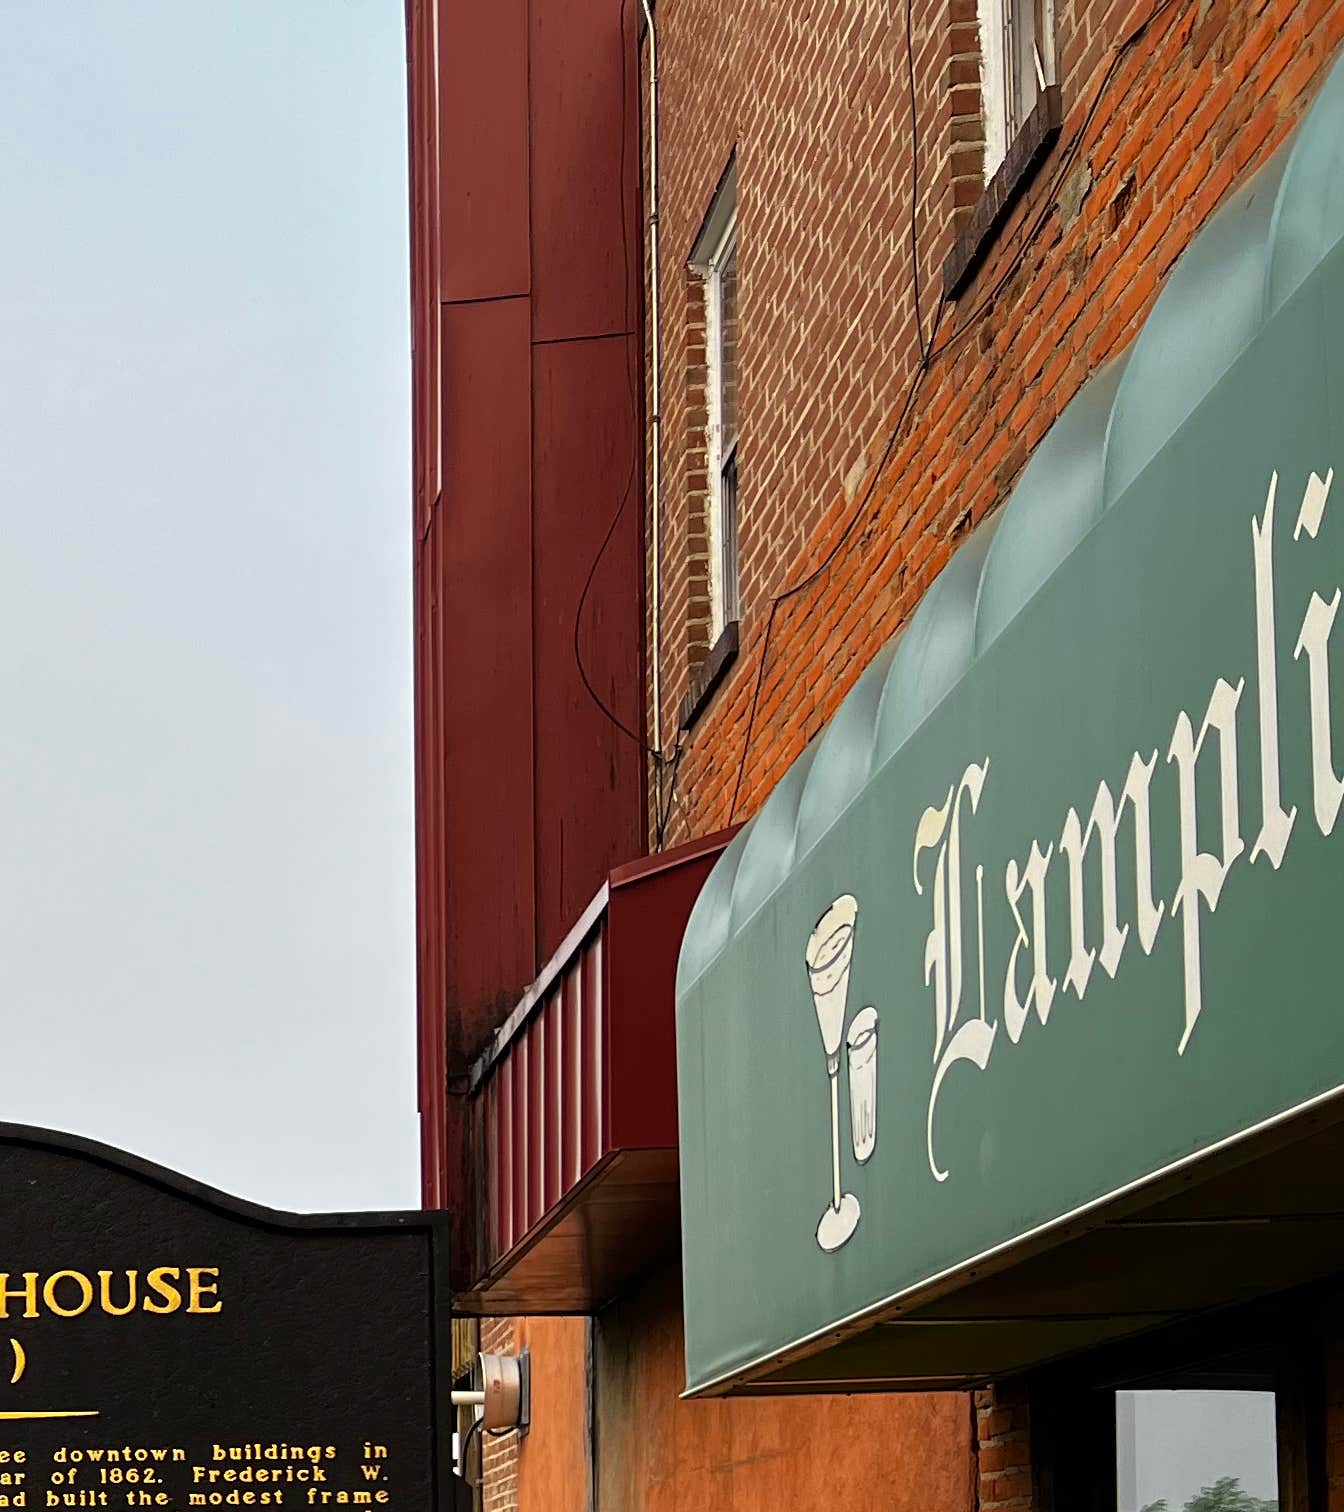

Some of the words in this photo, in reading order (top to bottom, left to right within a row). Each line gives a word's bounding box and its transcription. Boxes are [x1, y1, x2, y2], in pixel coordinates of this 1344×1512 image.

[53, 1446, 186, 1463] downtown
[212, 1442, 337, 1464] buildings
[363, 1441, 388, 1459] in
[50, 1467, 78, 1485] of
[100, 1467, 163, 1484] 1862.
[192, 1465, 327, 1483] Frederick
[360, 1464, 388, 1481] W.
[46, 1489, 108, 1507] built
[126, 1490, 169, 1506] the
[188, 1489, 283, 1506] modest
[306, 1487, 390, 1505] frame
